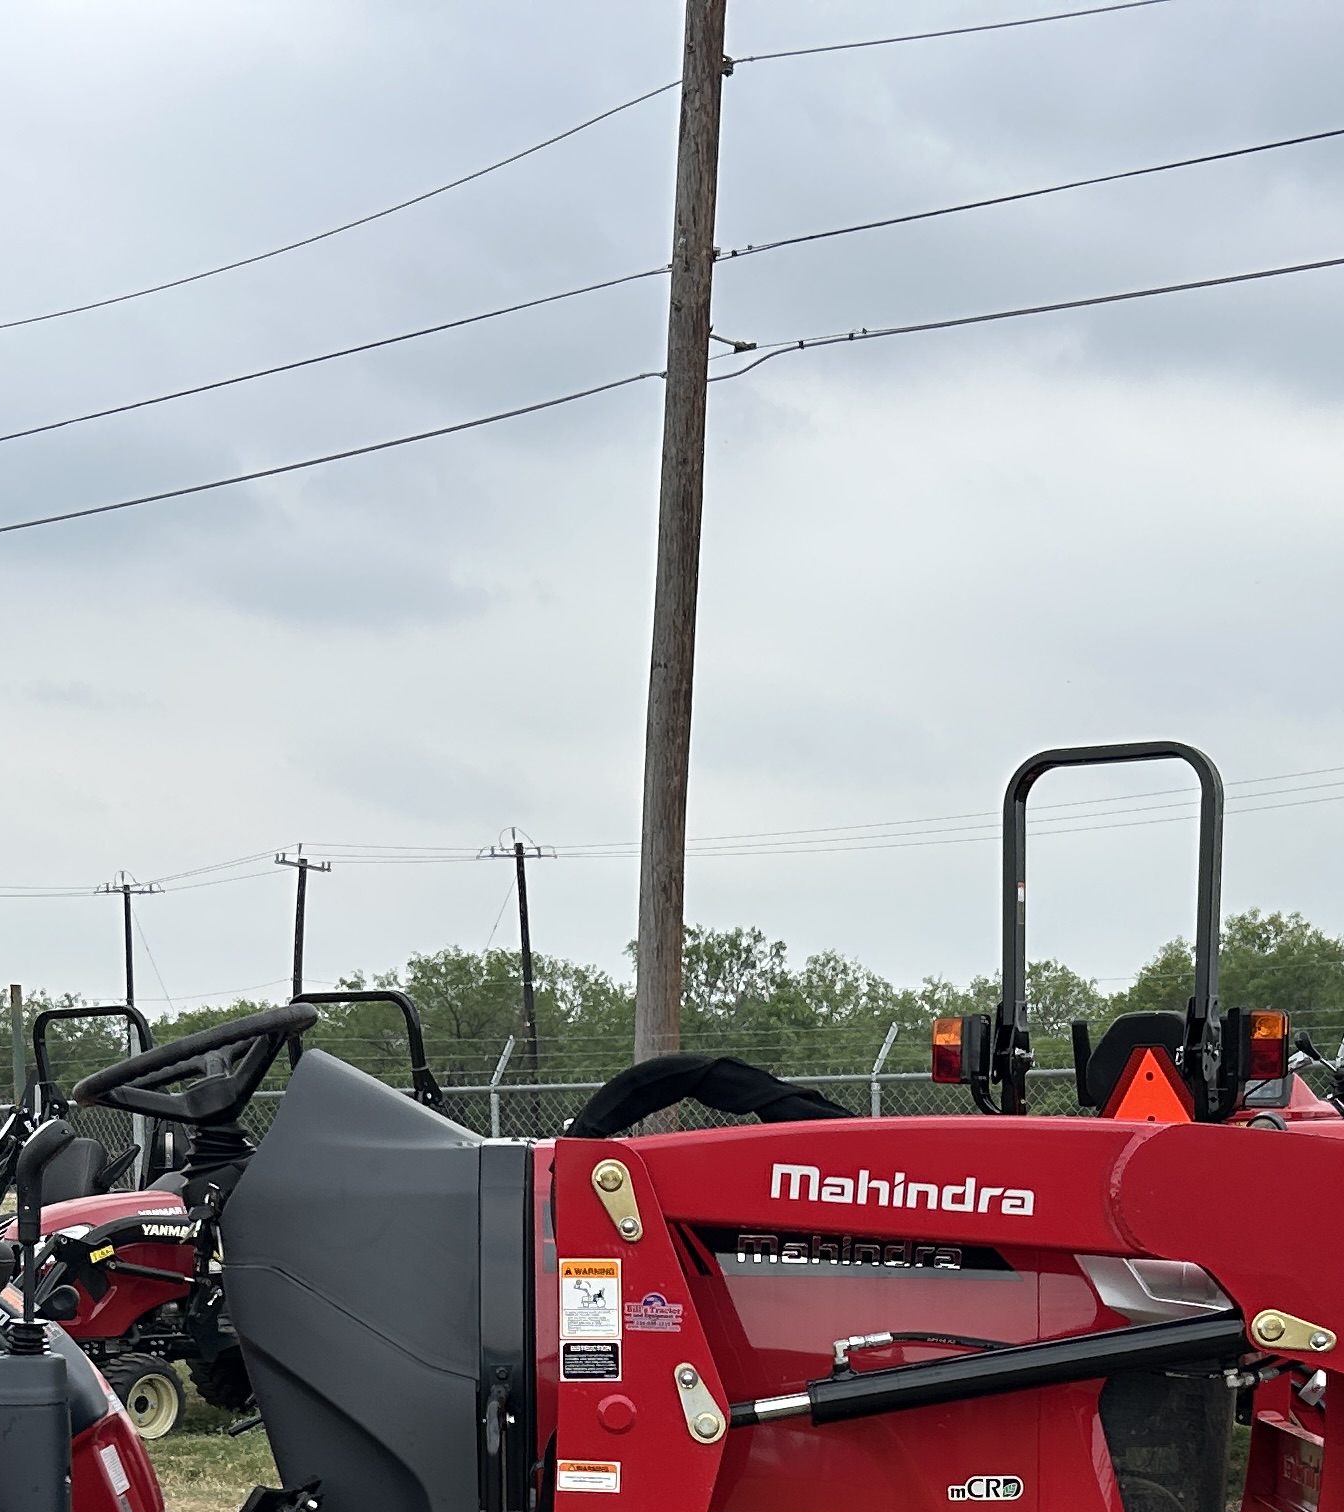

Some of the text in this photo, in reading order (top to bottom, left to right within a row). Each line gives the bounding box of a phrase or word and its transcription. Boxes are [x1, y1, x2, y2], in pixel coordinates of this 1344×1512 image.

[769, 1162, 1035, 1217] Mahindra
[736, 1234, 963, 1271] Mahindra
[573, 1267, 615, 1276] WARNING
